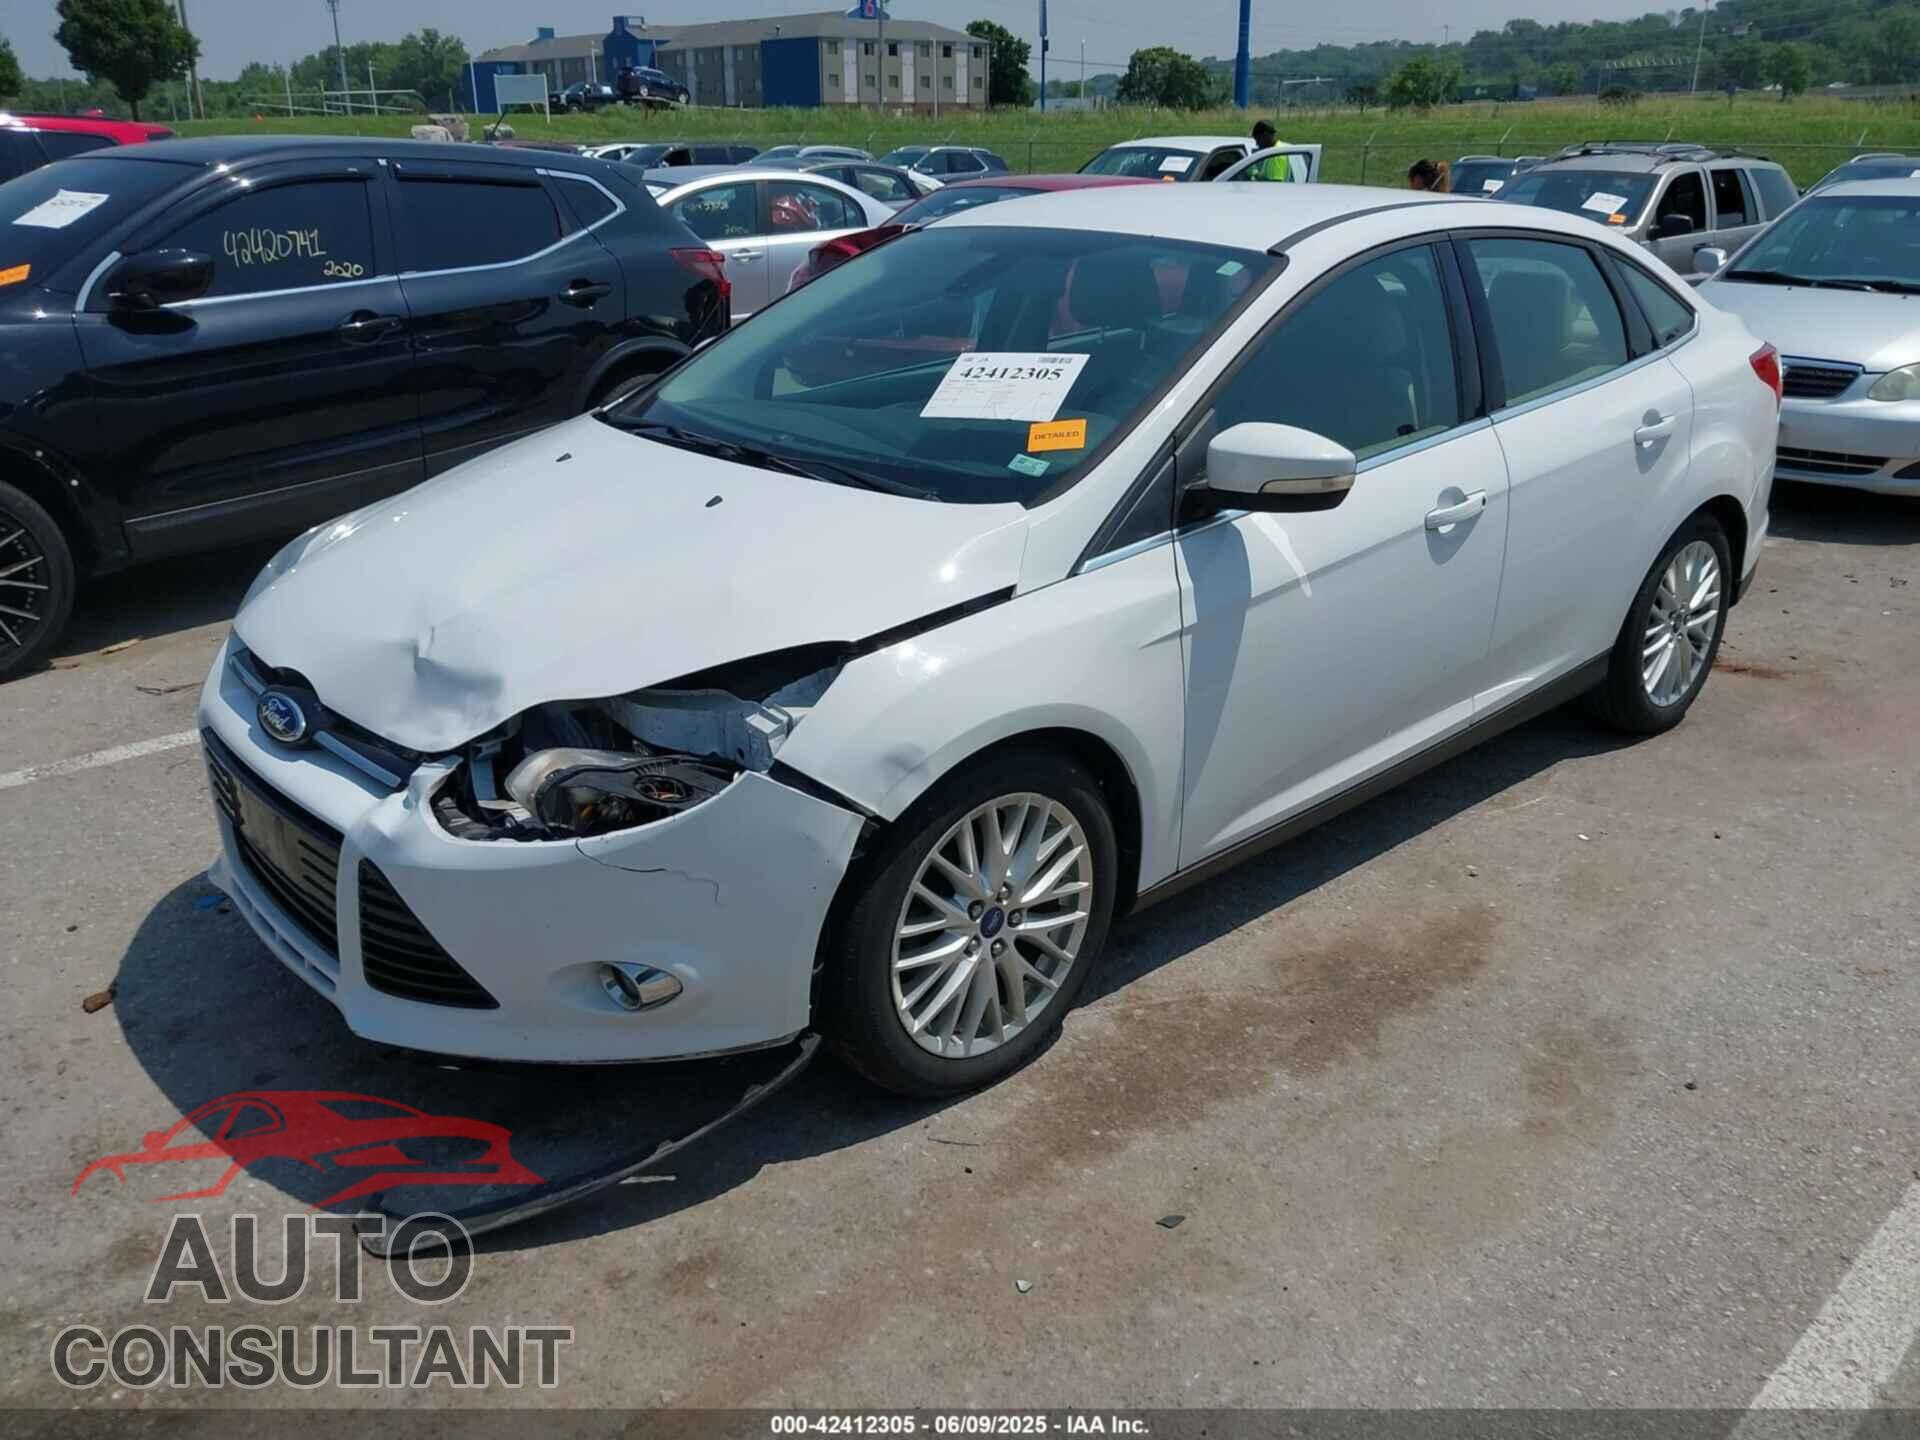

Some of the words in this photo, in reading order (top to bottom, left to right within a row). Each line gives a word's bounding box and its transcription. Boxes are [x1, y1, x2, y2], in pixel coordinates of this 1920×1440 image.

[223, 227, 327, 268] 42420741
[323, 260, 364, 278] 2020
[960, 367, 1064, 380] 42412305
[1034, 430, 1080, 440] DETAILED
[262, 698, 291, 733] Ford
